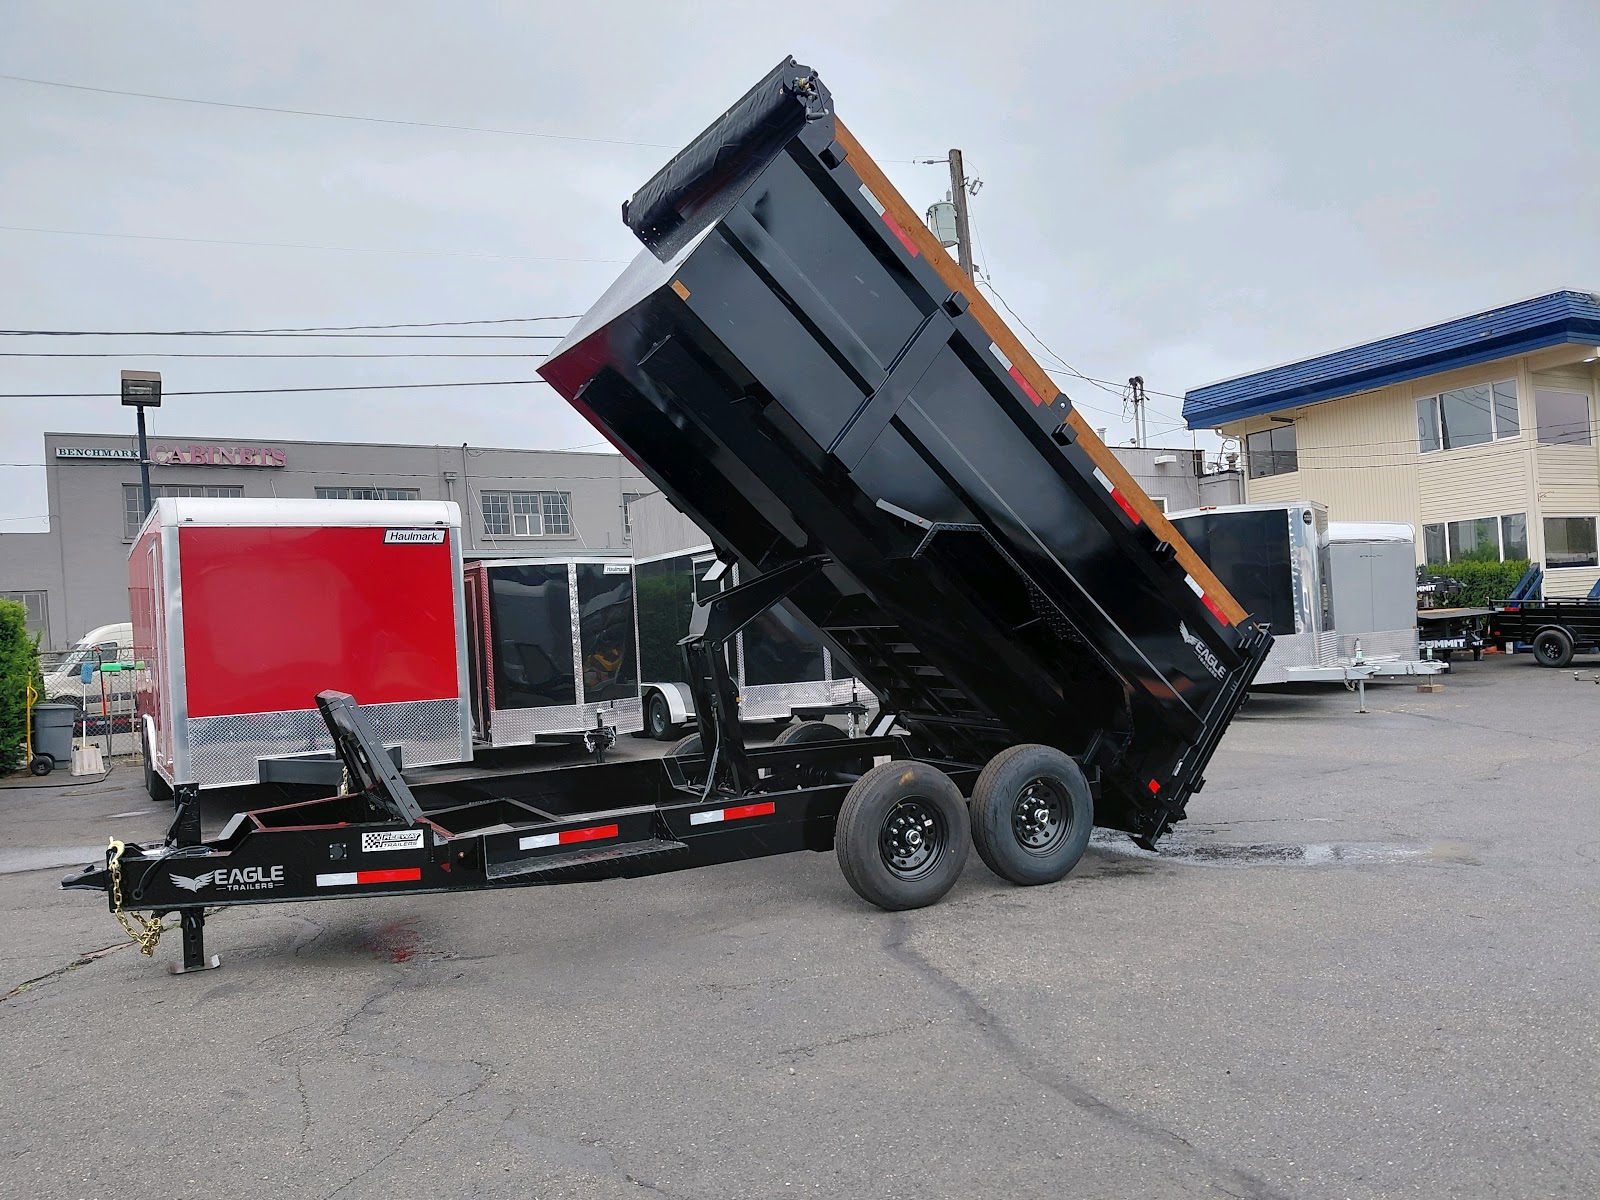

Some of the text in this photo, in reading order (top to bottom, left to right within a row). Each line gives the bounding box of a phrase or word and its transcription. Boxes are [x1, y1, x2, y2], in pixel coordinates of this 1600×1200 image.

[58, 445, 287, 466] BENCHMARK CABINETS
[390, 531, 439, 541] Haulmark
[1418, 638, 1466, 649] SUMMIT
[1194, 640, 1227, 679] EAGLE
[214, 865, 285, 885] EAGLE
[226, 882, 274, 892] TRAILERS
